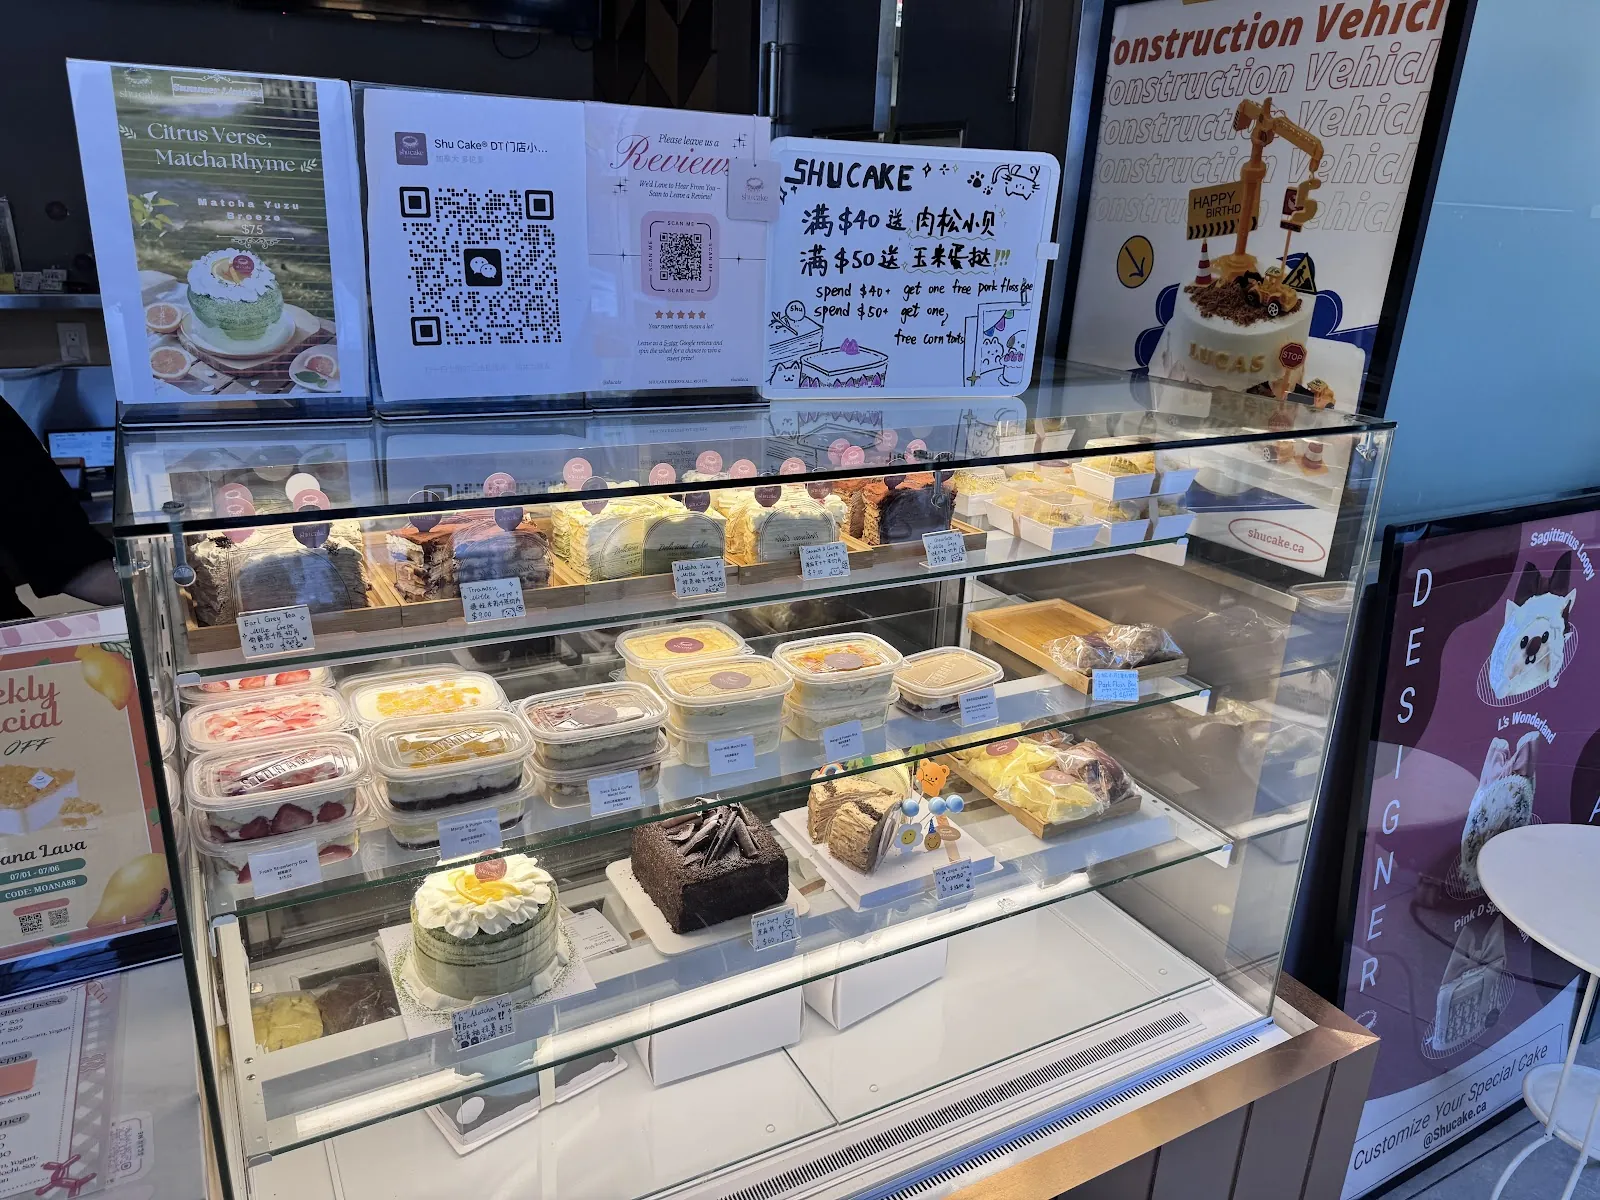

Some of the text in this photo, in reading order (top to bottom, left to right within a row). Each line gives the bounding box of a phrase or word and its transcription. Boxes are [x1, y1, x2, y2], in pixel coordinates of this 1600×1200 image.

[1110, 12, 1303, 65] onstruction
[147, 122, 272, 148] Citrus Verse,
[434, 138, 454, 149] Shu
[658, 134, 682, 145] Please
[683, 136, 703, 146] leave
[704, 139, 713, 147] us
[155, 148, 296, 174] Matcha Rhyme
[609, 134, 729, 177] Review
[784, 158, 914, 192] SHUCAKE
[648, 190, 662, 198] Scan
[669, 191, 686, 199] Leave
[654, 181, 668, 189] Love
[675, 182, 689, 190] Hear
[705, 183, 716, 191] You
[197, 198, 299, 210] Matcha Yuzu
[1193, 190, 1236, 209] HAPPY
[226, 211, 281, 221] Breeze
[1206, 203, 1242, 218] BIRTHD
[241, 223, 264, 235] $75
[816, 283, 852, 299] spend
[903, 284, 922, 301] get
[928, 285, 945, 296] one
[952, 282, 972, 296] free
[978, 283, 998, 297] pork
[814, 303, 850, 323] spend
[900, 305, 921, 325] get
[894, 333, 919, 346] free
[923, 334, 944, 345] corn
[1189, 341, 1266, 374] LUCAS
[1283, 350, 1303, 361] STOP
[1248, 528, 1304, 554] shucake.ca
[1530, 527, 1596, 582] Sagittarius Loopy
[244, 617, 261, 627] Earl
[264, 615, 281, 623] Grey
[1511, 710, 1557, 745] Wonderland
[4, 736, 56, 756] OFF
[39, 840, 88, 858] Lava
[10, 864, 60, 881] 07/01 07/06
[5, 878, 77, 899] CODE: MOANA88
[1453, 904, 1485, 933] Pink D
[470, 1005, 494, 1017] Matcha
[1353, 1044, 1548, 1171] Customize Your Special Cake
[1423, 1101, 1487, 1150] @Shucake.ca
